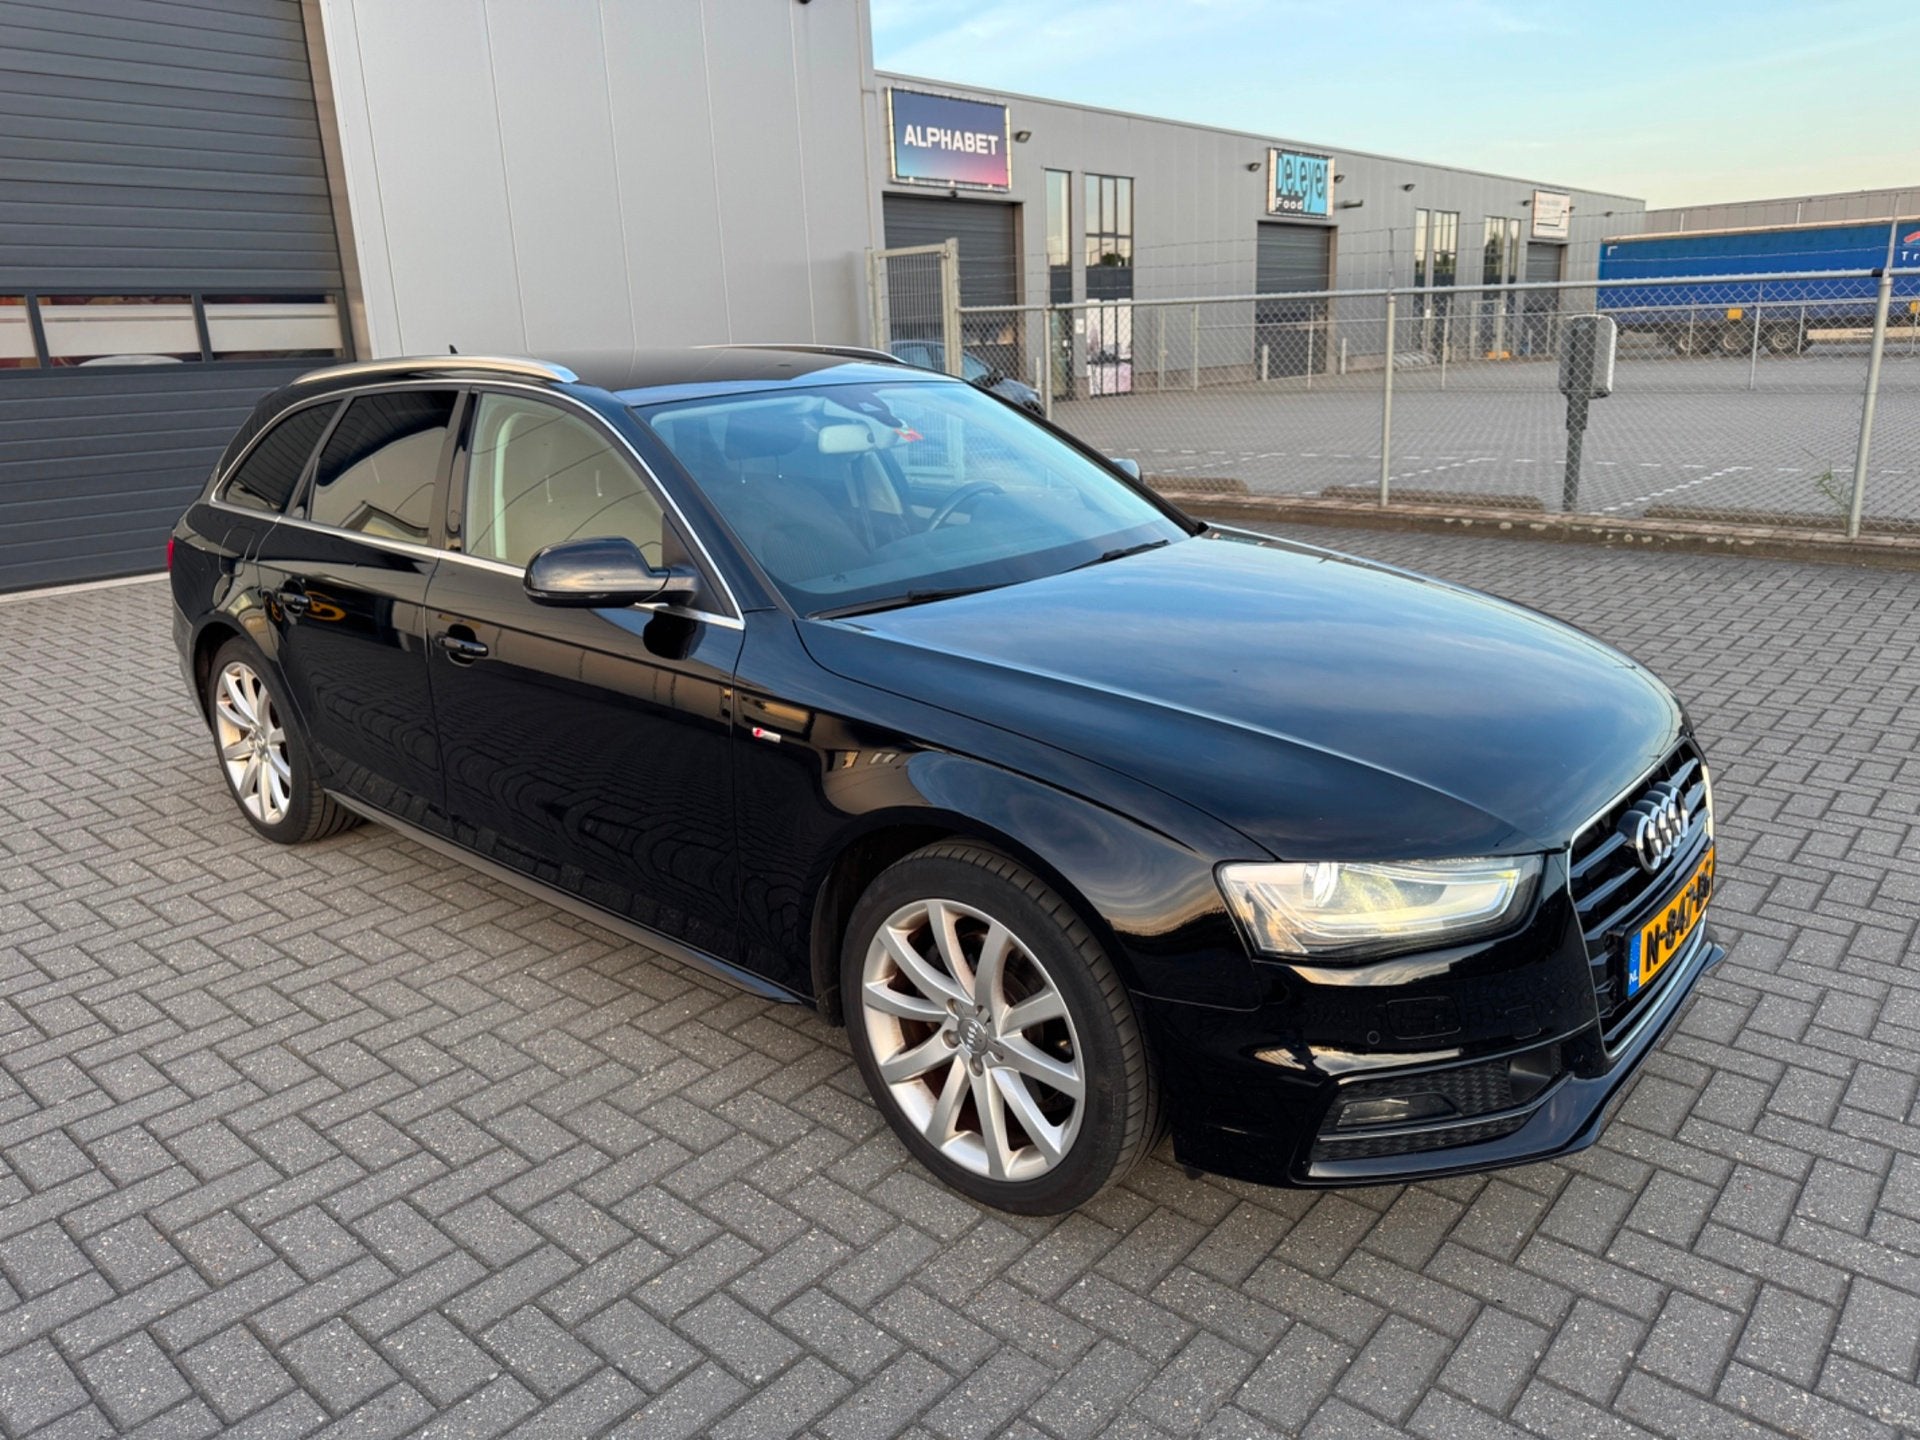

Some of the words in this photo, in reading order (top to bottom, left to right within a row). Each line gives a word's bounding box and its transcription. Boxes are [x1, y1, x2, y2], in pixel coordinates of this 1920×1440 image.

[904, 124, 999, 156] ALPHABET
[1276, 197, 1304, 210] Food
[1629, 970, 1639, 986] NL
